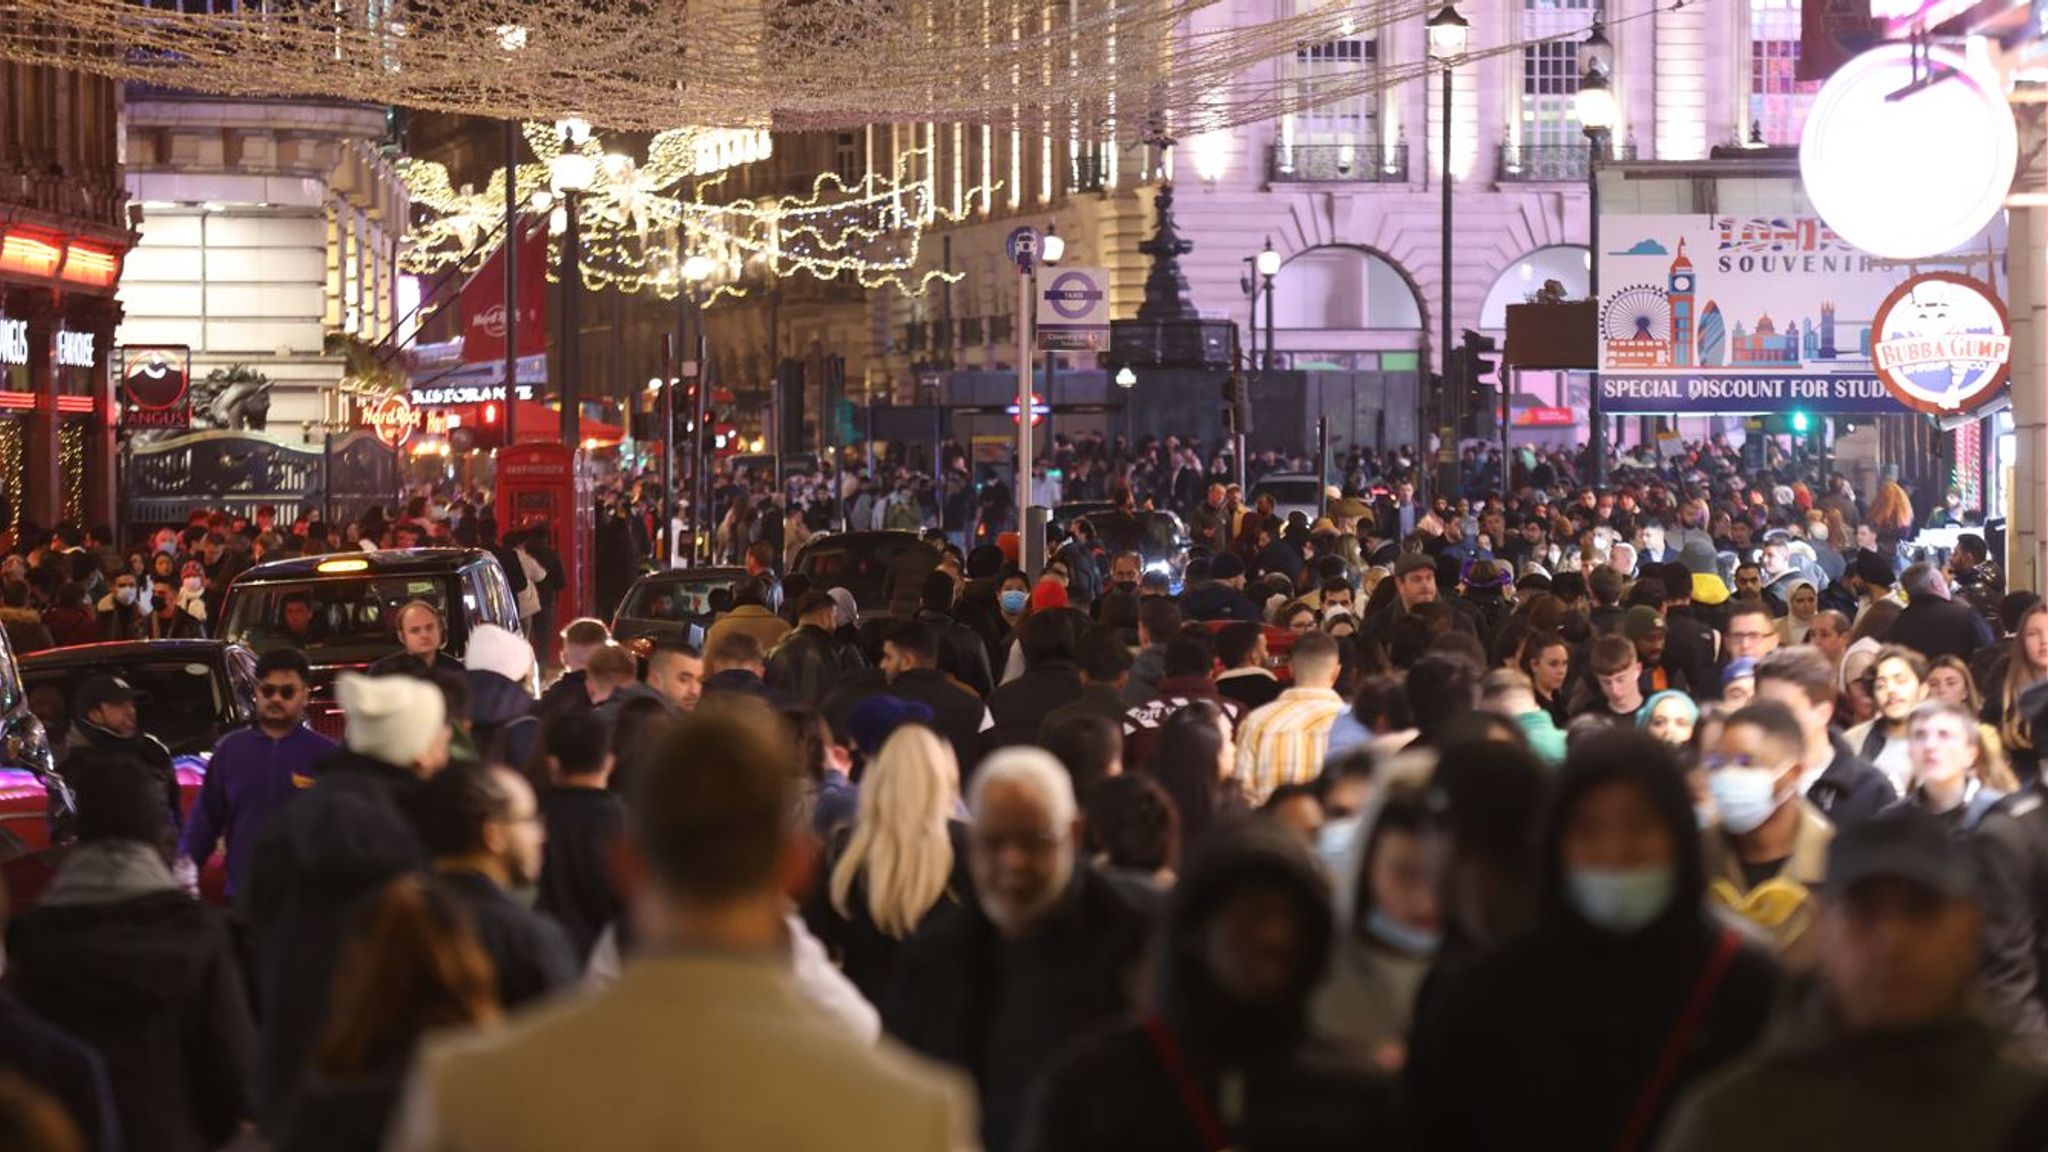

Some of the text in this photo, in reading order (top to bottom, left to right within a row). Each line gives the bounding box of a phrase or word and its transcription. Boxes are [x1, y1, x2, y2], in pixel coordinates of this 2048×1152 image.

[1881, 337, 2005, 365] BUBBA GUMP
[1605, 379, 1682, 398] SPECIAL
[1689, 379, 1784, 399] DISCOUNT
[1790, 379, 1828, 398] FOR
[127, 411, 185, 424] ANGUS
